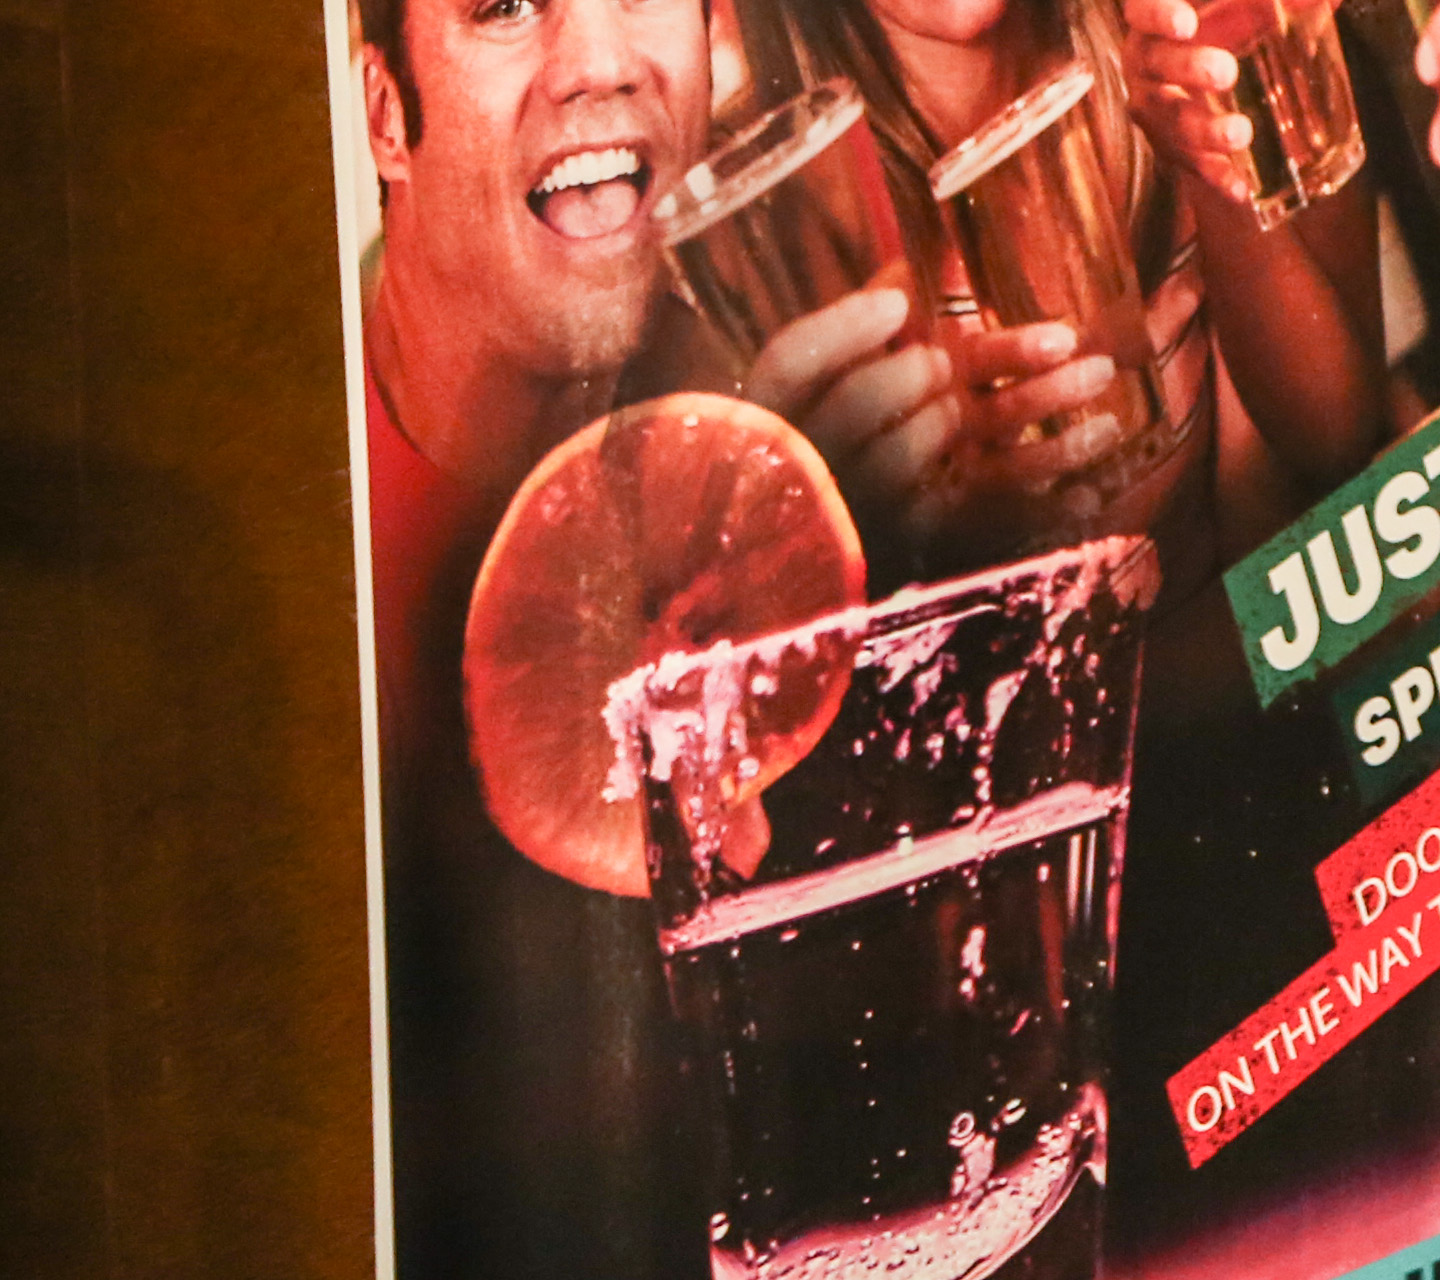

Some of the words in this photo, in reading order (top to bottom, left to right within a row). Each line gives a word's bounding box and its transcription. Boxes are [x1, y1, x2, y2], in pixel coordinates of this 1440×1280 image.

[1185, 1061, 1256, 1132] ON
[1254, 988, 1339, 1073] THE
[1336, 914, 1424, 1009] WAY
